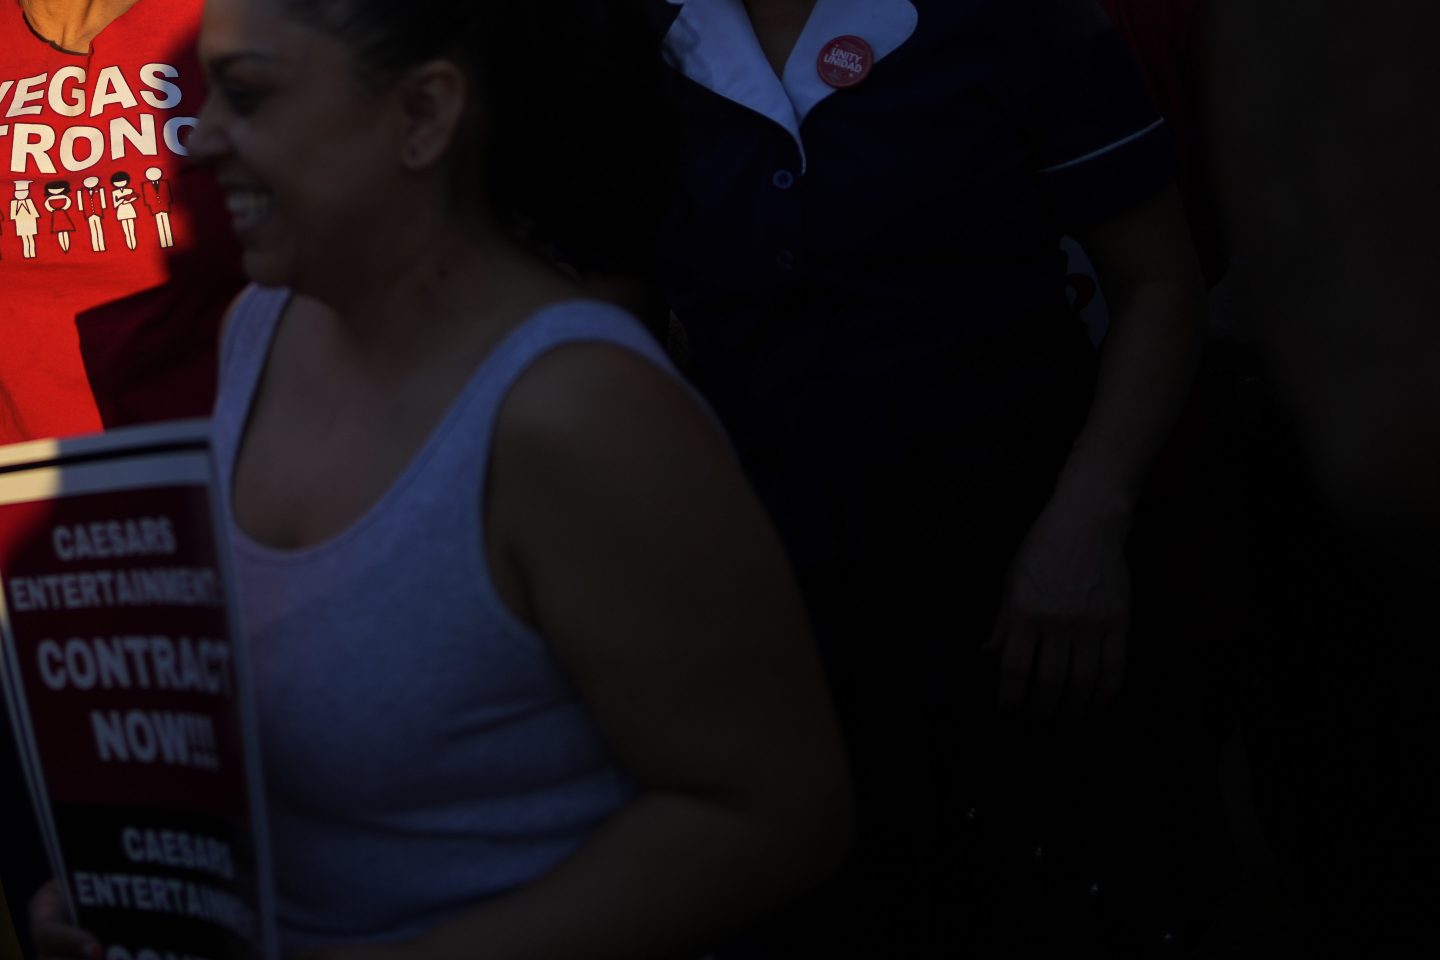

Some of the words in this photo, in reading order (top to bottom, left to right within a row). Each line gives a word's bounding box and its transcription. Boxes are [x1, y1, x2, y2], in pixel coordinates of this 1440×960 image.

[832, 47, 863, 65] UNITY
[51, 513, 179, 562] CAESARS
[36, 637, 232, 699] CONTRACT
[89, 708, 222, 773] NOW!!!
